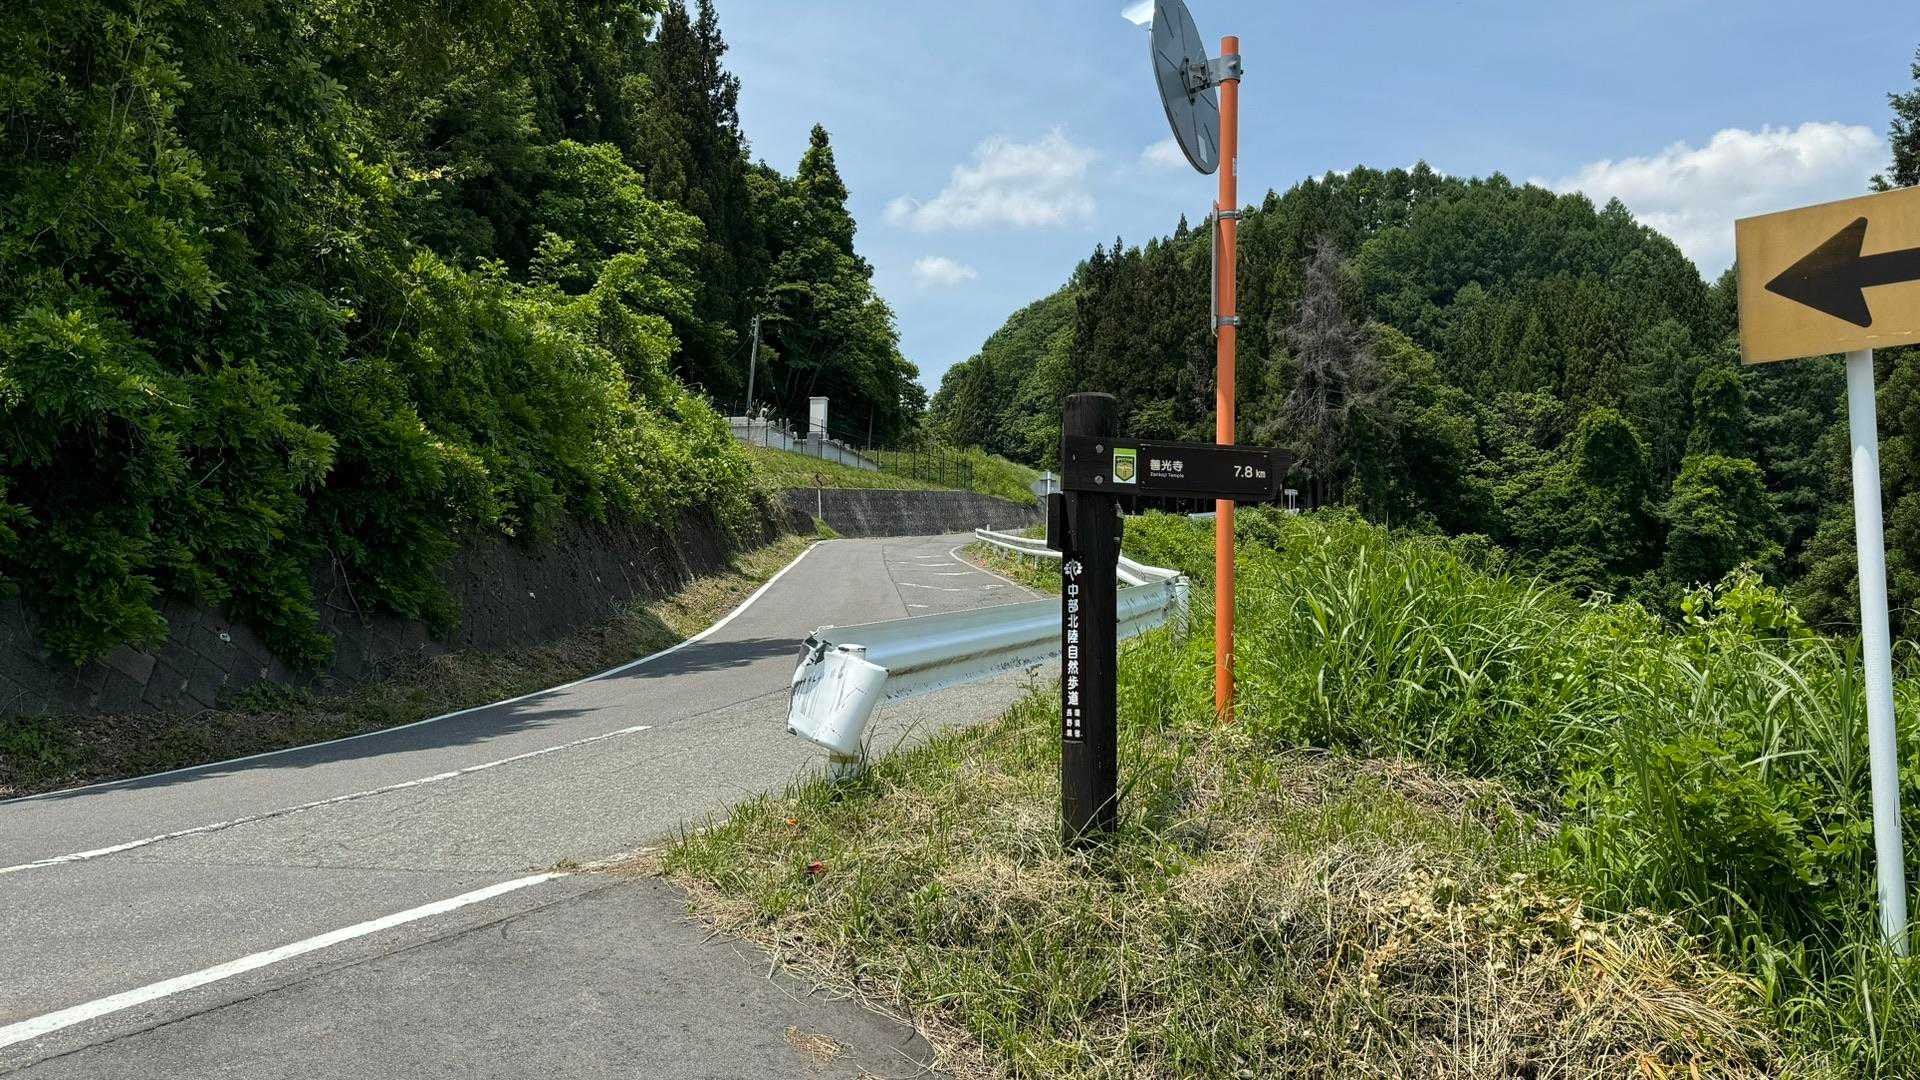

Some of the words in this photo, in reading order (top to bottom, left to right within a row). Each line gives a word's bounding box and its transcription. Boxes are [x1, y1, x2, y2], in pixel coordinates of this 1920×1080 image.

[1150, 459, 1183, 472] 善光寺
[1233, 465, 1253, 478] 7.8
[1255, 469, 1266, 479] km
[1067, 583, 1079, 705] 中部北陸自然歩道
